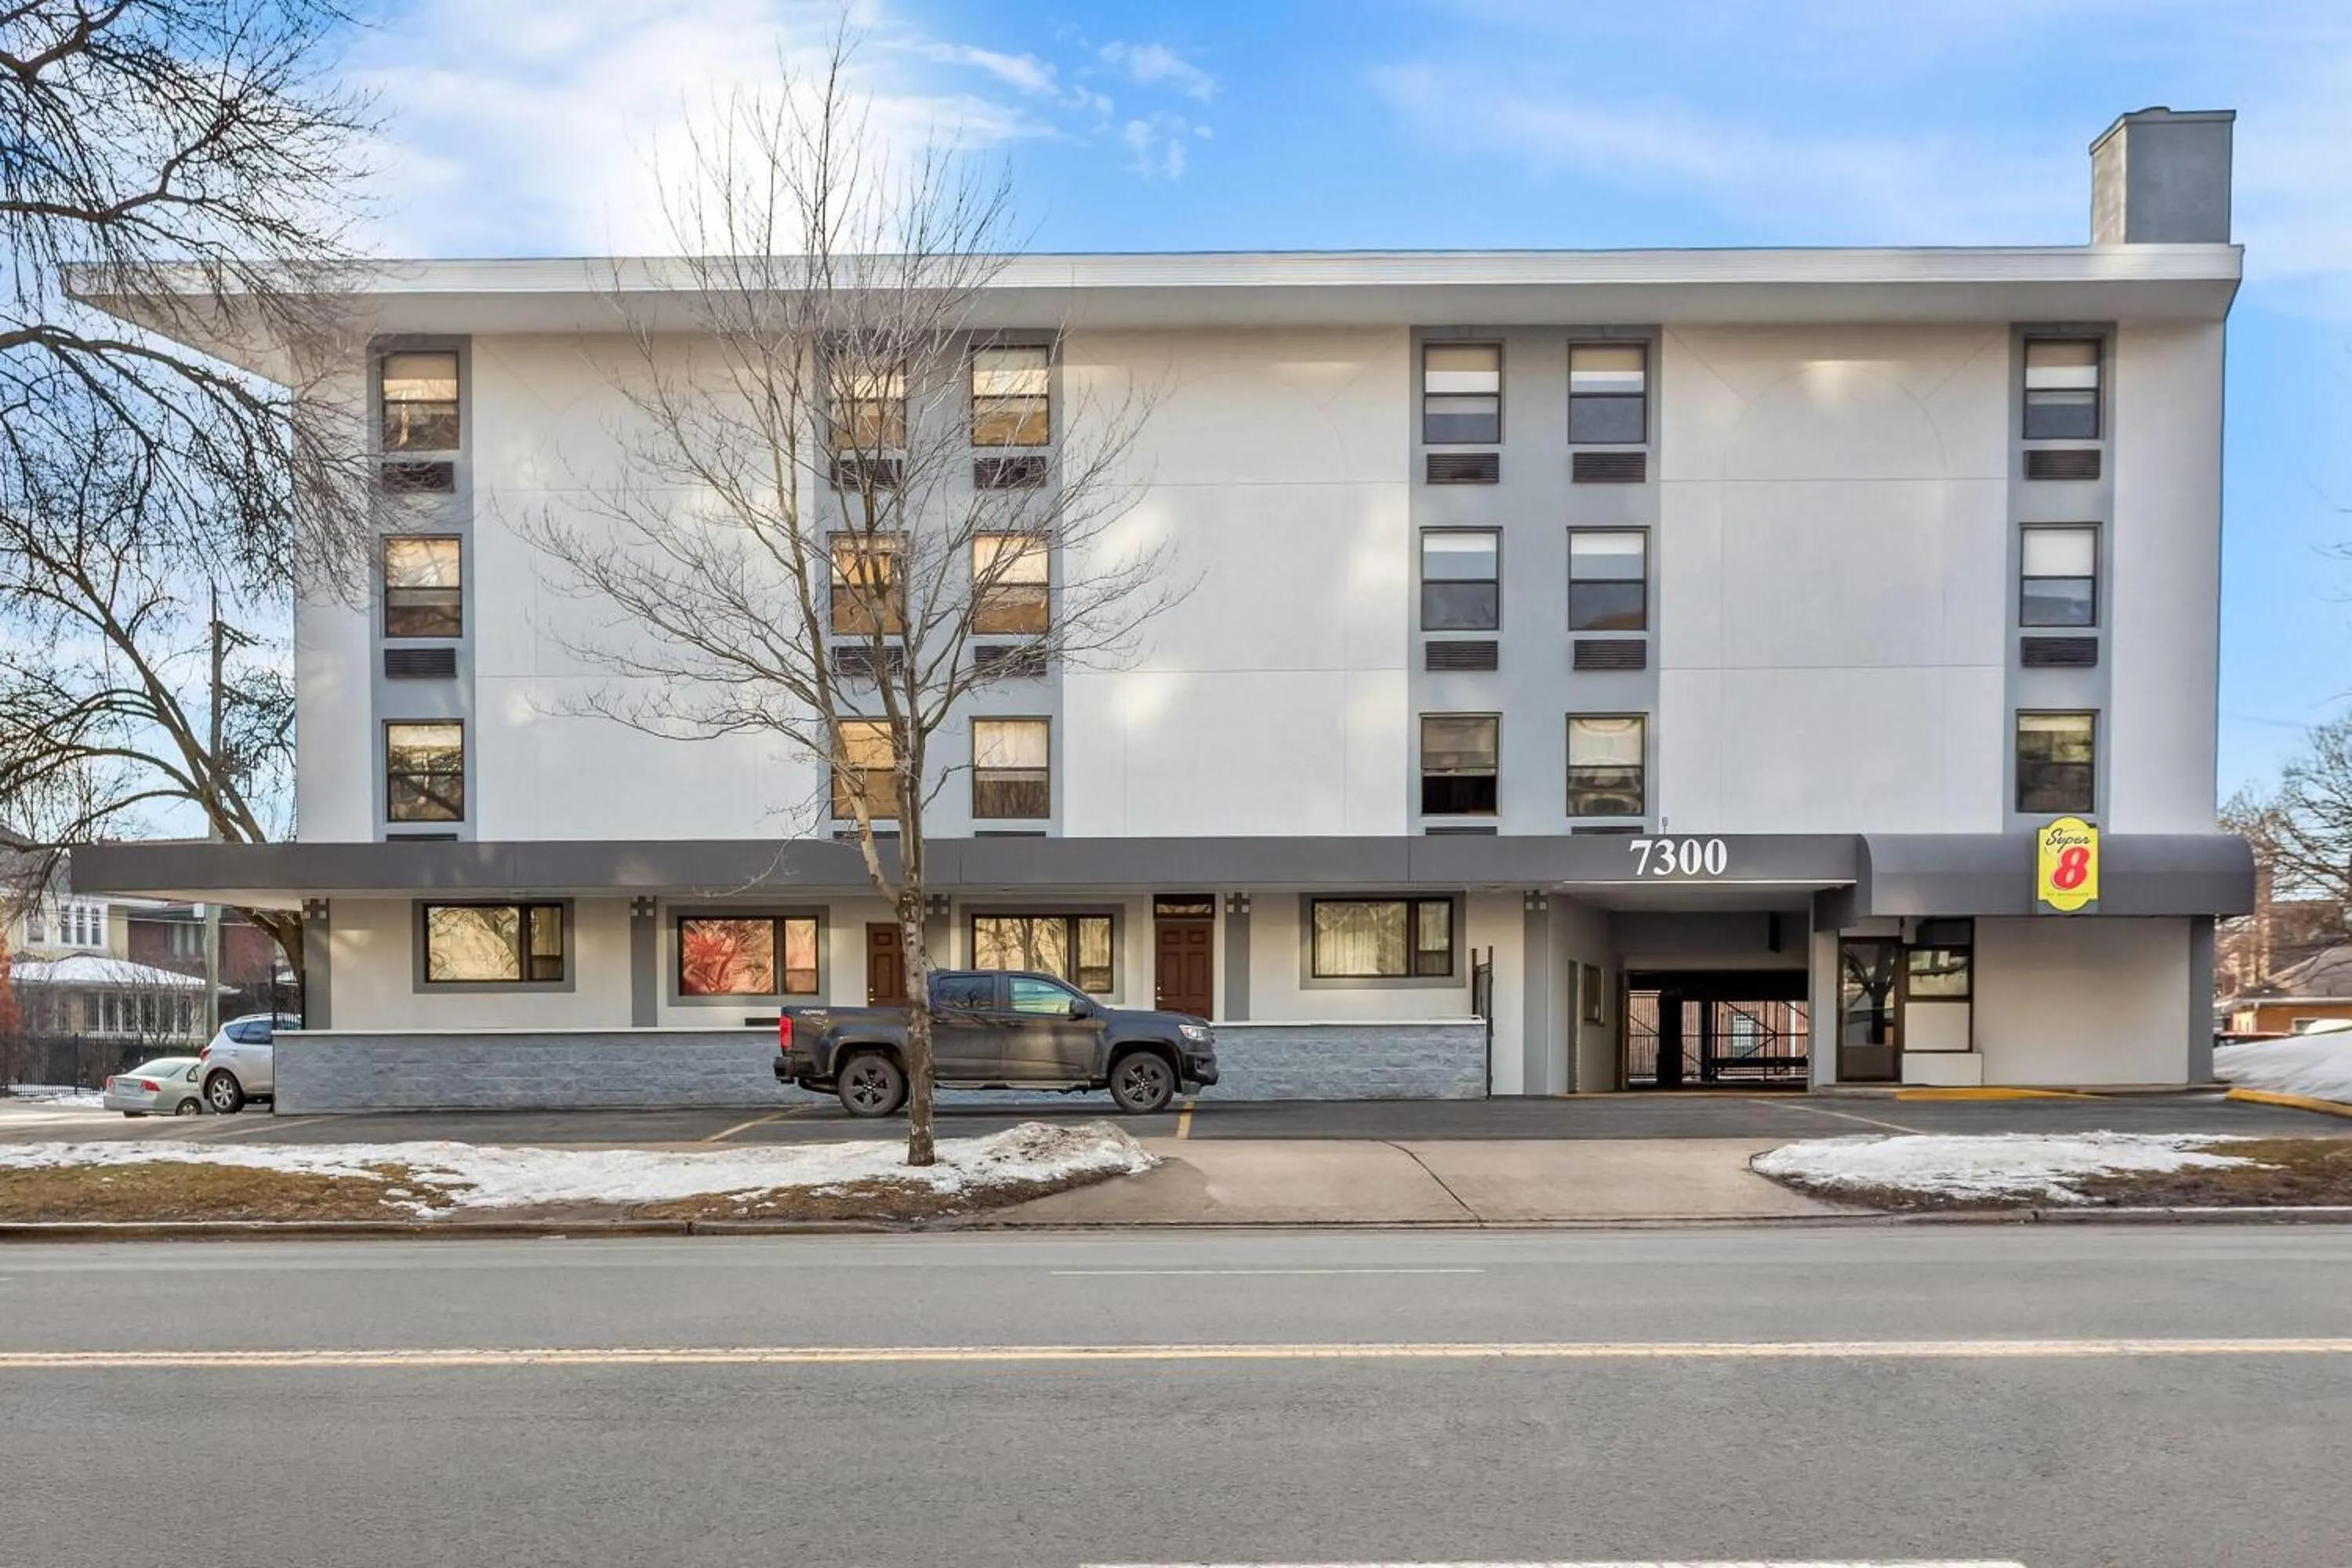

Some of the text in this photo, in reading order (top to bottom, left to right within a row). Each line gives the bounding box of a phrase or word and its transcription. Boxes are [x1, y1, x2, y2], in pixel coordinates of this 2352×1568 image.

[1629, 838, 1727, 876] 7300
[2045, 828, 2090, 853] Super
[2052, 847, 2090, 890] 8
